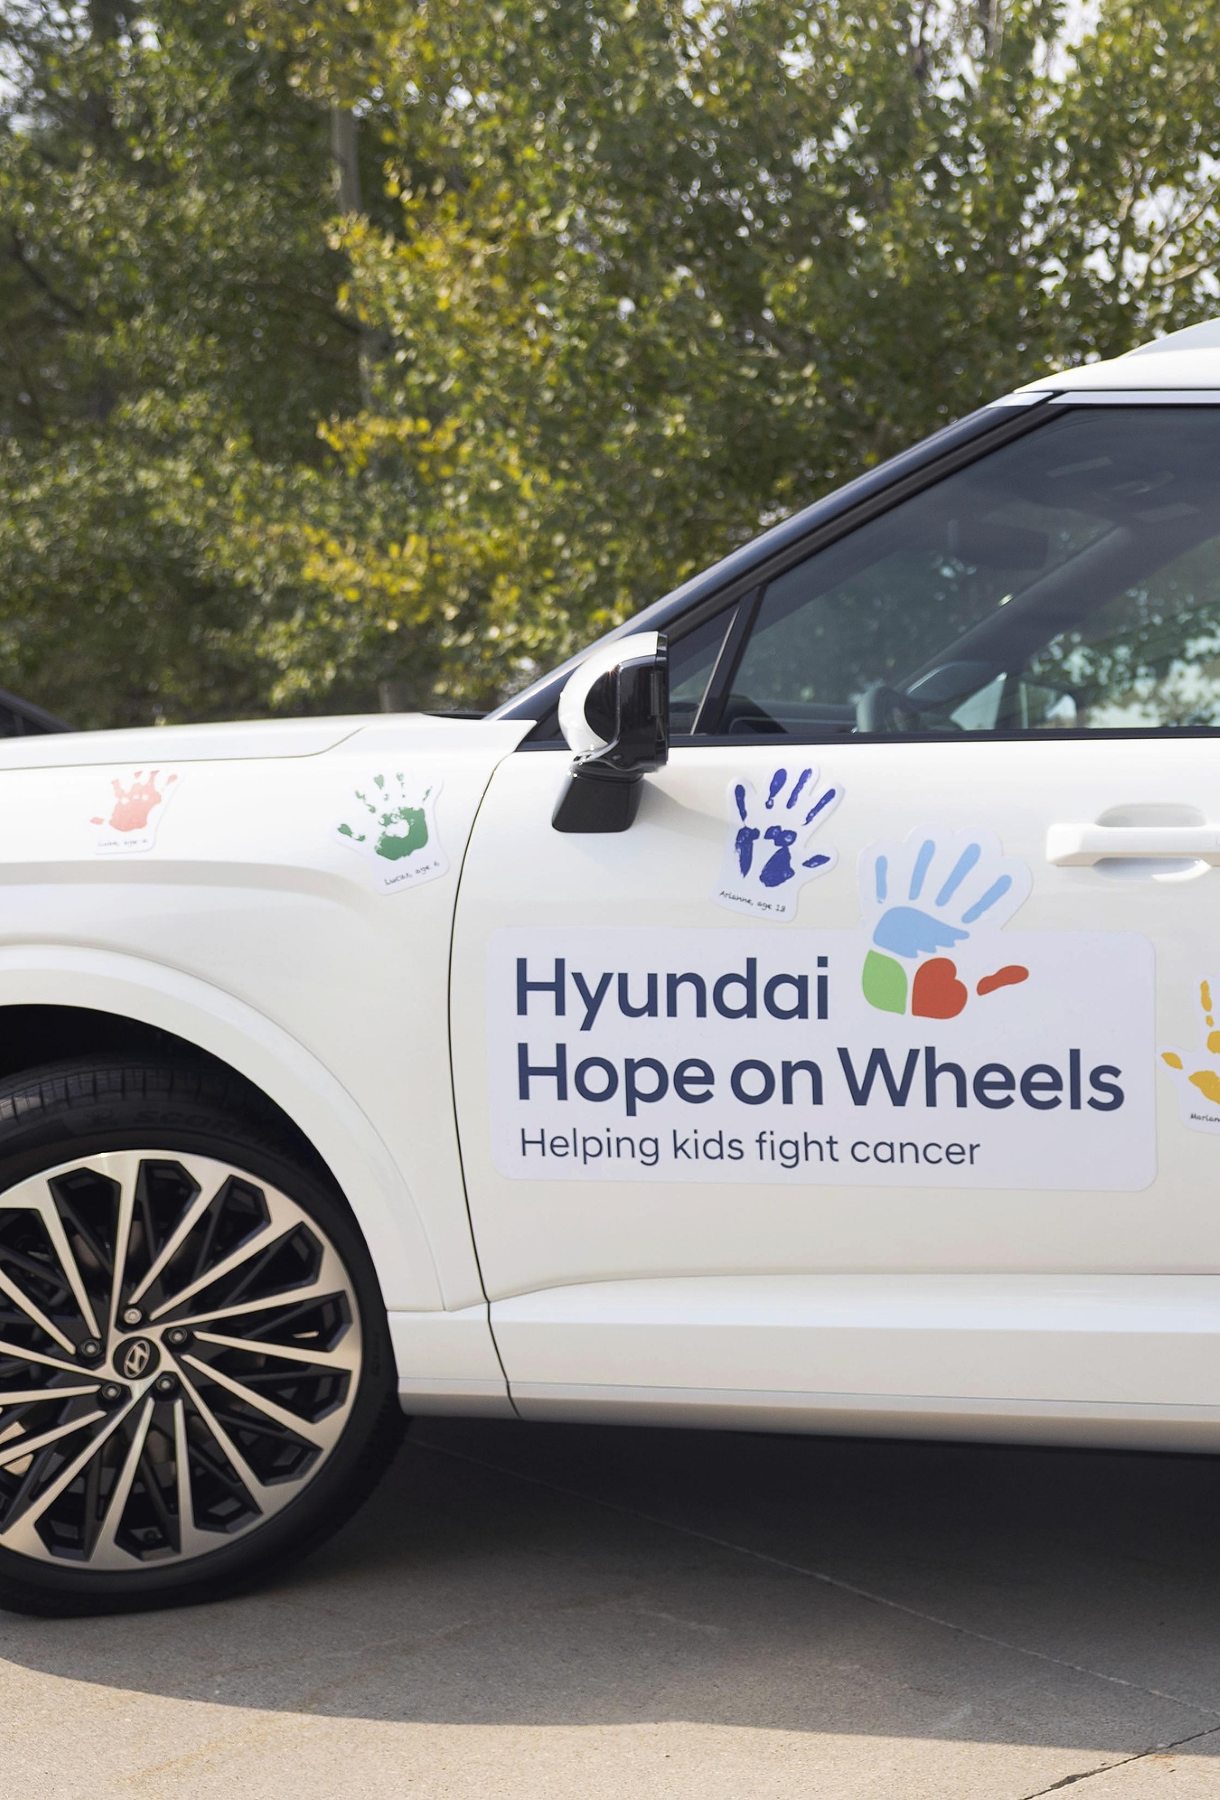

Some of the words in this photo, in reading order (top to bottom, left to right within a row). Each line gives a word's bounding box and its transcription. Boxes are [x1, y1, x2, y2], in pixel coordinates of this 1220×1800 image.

[415, 864, 430, 875] age
[756, 901, 773, 911] age
[517, 956, 829, 1032] Hyundai
[518, 1043, 715, 1117] Hope
[731, 1060, 824, 1106] on
[837, 1046, 1125, 1113] Wheels
[521, 1127, 659, 1167] Helping
[672, 1129, 745, 1161] kids
[755, 1130, 840, 1169] fight
[850, 1140, 981, 1165] cancer
